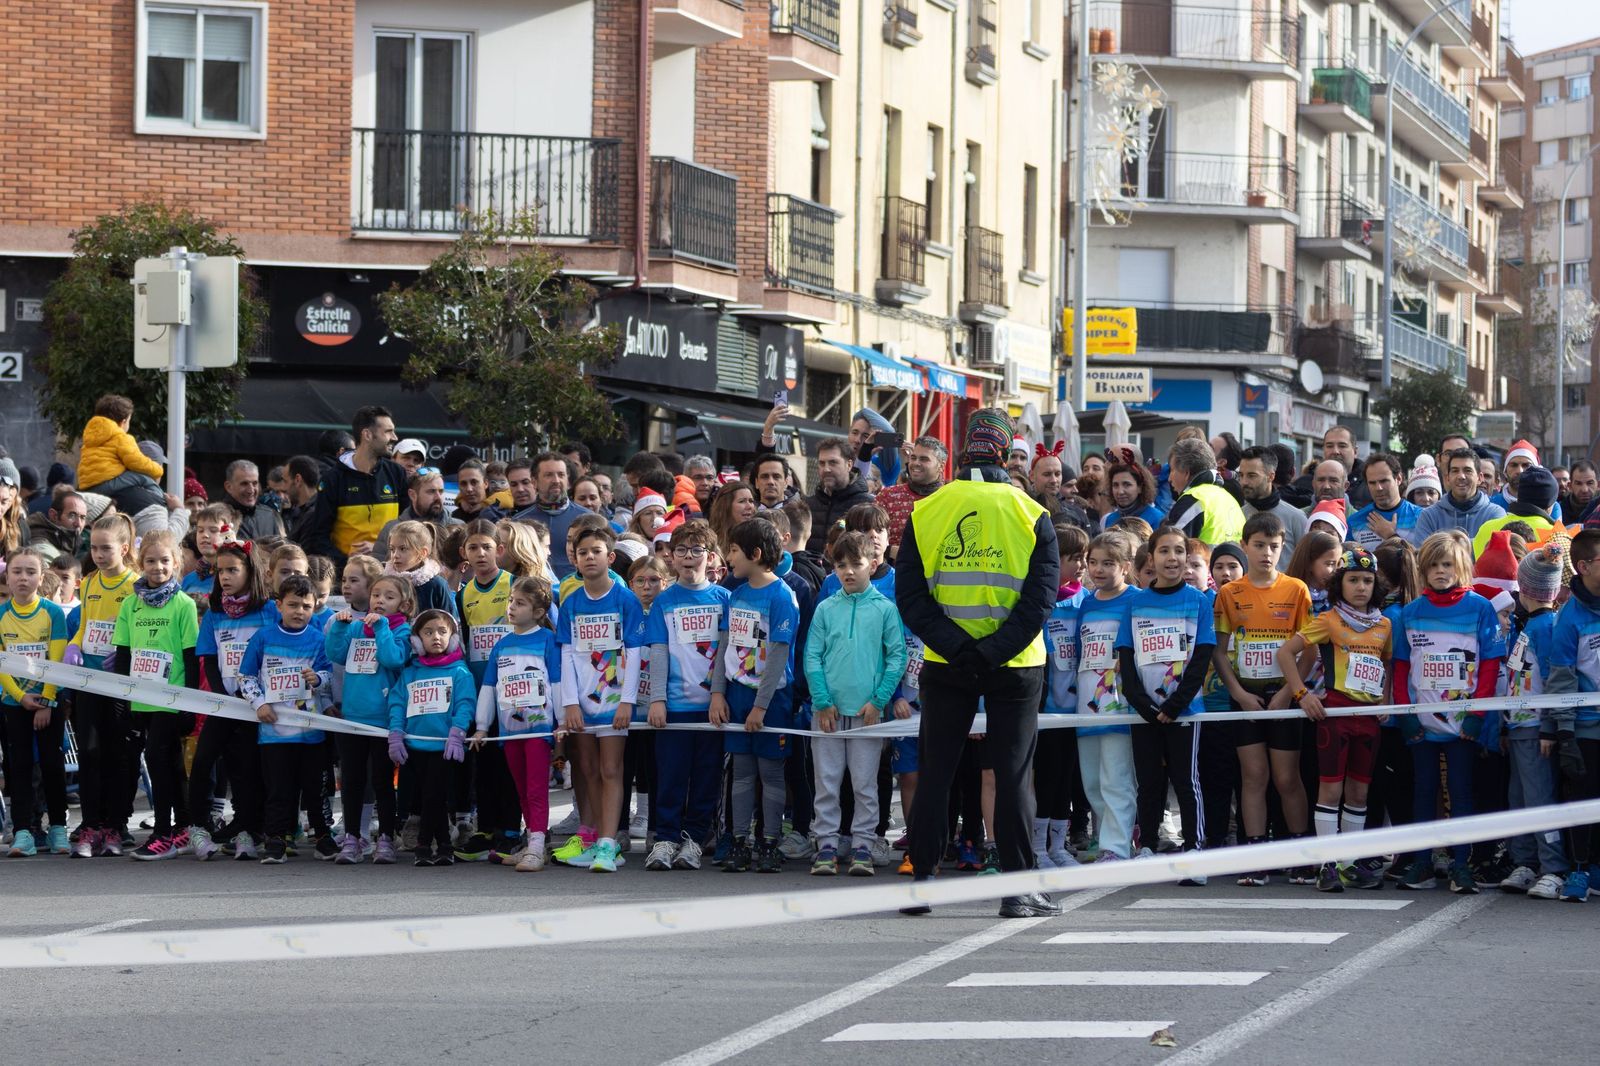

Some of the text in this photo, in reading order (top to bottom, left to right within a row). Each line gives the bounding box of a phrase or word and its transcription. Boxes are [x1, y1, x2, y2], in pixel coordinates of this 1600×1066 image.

[306, 306, 351, 320] Estrella
[307, 319, 348, 333] Galicia
[1, 355, 18, 379] 2
[942, 561, 1003, 569] ALMANINA
[687, 607, 719, 615] SETEL
[735, 610, 756, 619] SETEL
[584, 615, 616, 624] SETEL
[681, 615, 712, 632] 6687
[579, 624, 609, 640] 6682
[1086, 634, 1114, 643] SETEL
[1147, 627, 1181, 636] SETEL
[1142, 635, 1174, 653] 6694
[1248, 642, 1280, 650] SETEL
[141, 650, 168, 660] SETEL
[1245, 651, 1273, 667] 6719
[133, 657, 160, 673] 6969
[1424, 662, 1454, 678] 6998
[507, 672, 538, 682] SETEL
[1354, 663, 1381, 683] 6838
[270, 674, 300, 691] 6729
[416, 680, 448, 688] SETEL
[413, 687, 439, 704] 6971
